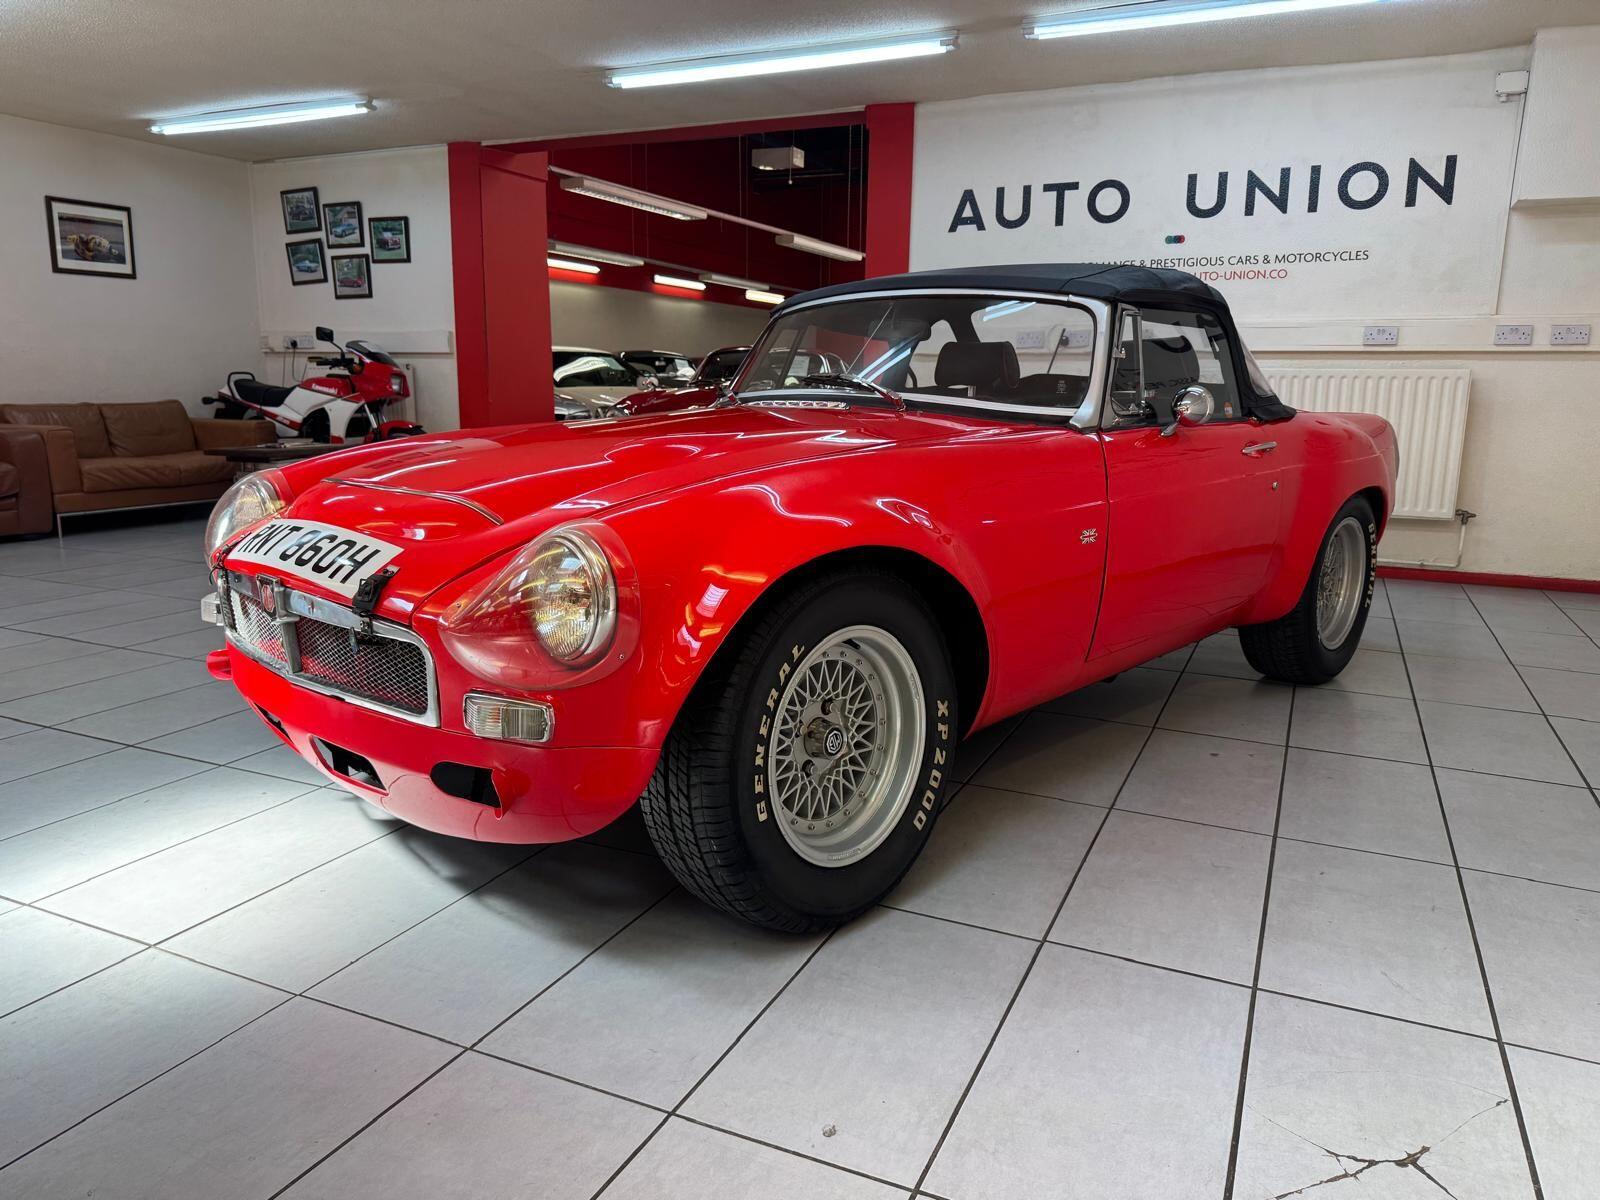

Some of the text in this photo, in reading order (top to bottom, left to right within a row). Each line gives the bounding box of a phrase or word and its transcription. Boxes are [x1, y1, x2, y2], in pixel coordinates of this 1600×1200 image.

[948, 155, 1458, 232] AUTO UNION
[1149, 255, 1224, 269] PRESTIGIOUS
[1227, 254, 1259, 266] CARS
[1262, 254, 1271, 265] &
[1274, 250, 1369, 265] MOTORCYCLES
[279, 529, 381, 584] 860H
[755, 644, 805, 823] GENERAL
[913, 747, 947, 831] 2000
